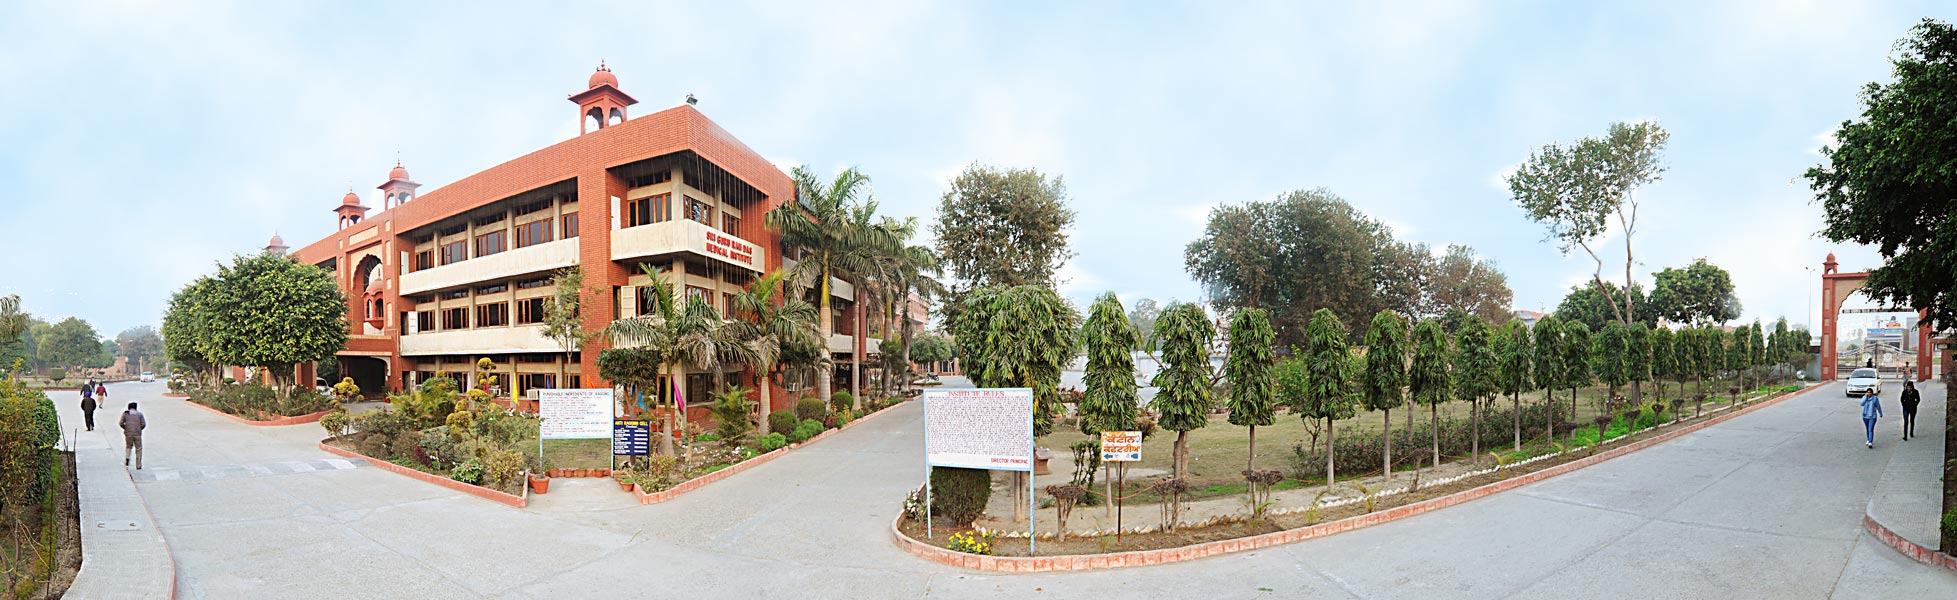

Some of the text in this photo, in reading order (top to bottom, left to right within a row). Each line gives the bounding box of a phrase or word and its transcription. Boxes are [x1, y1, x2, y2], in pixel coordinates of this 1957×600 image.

[706, 231, 716, 242] SRI
[717, 235, 731, 247] GURU
[706, 242, 753, 265] MEDICAL INSTITUTE
